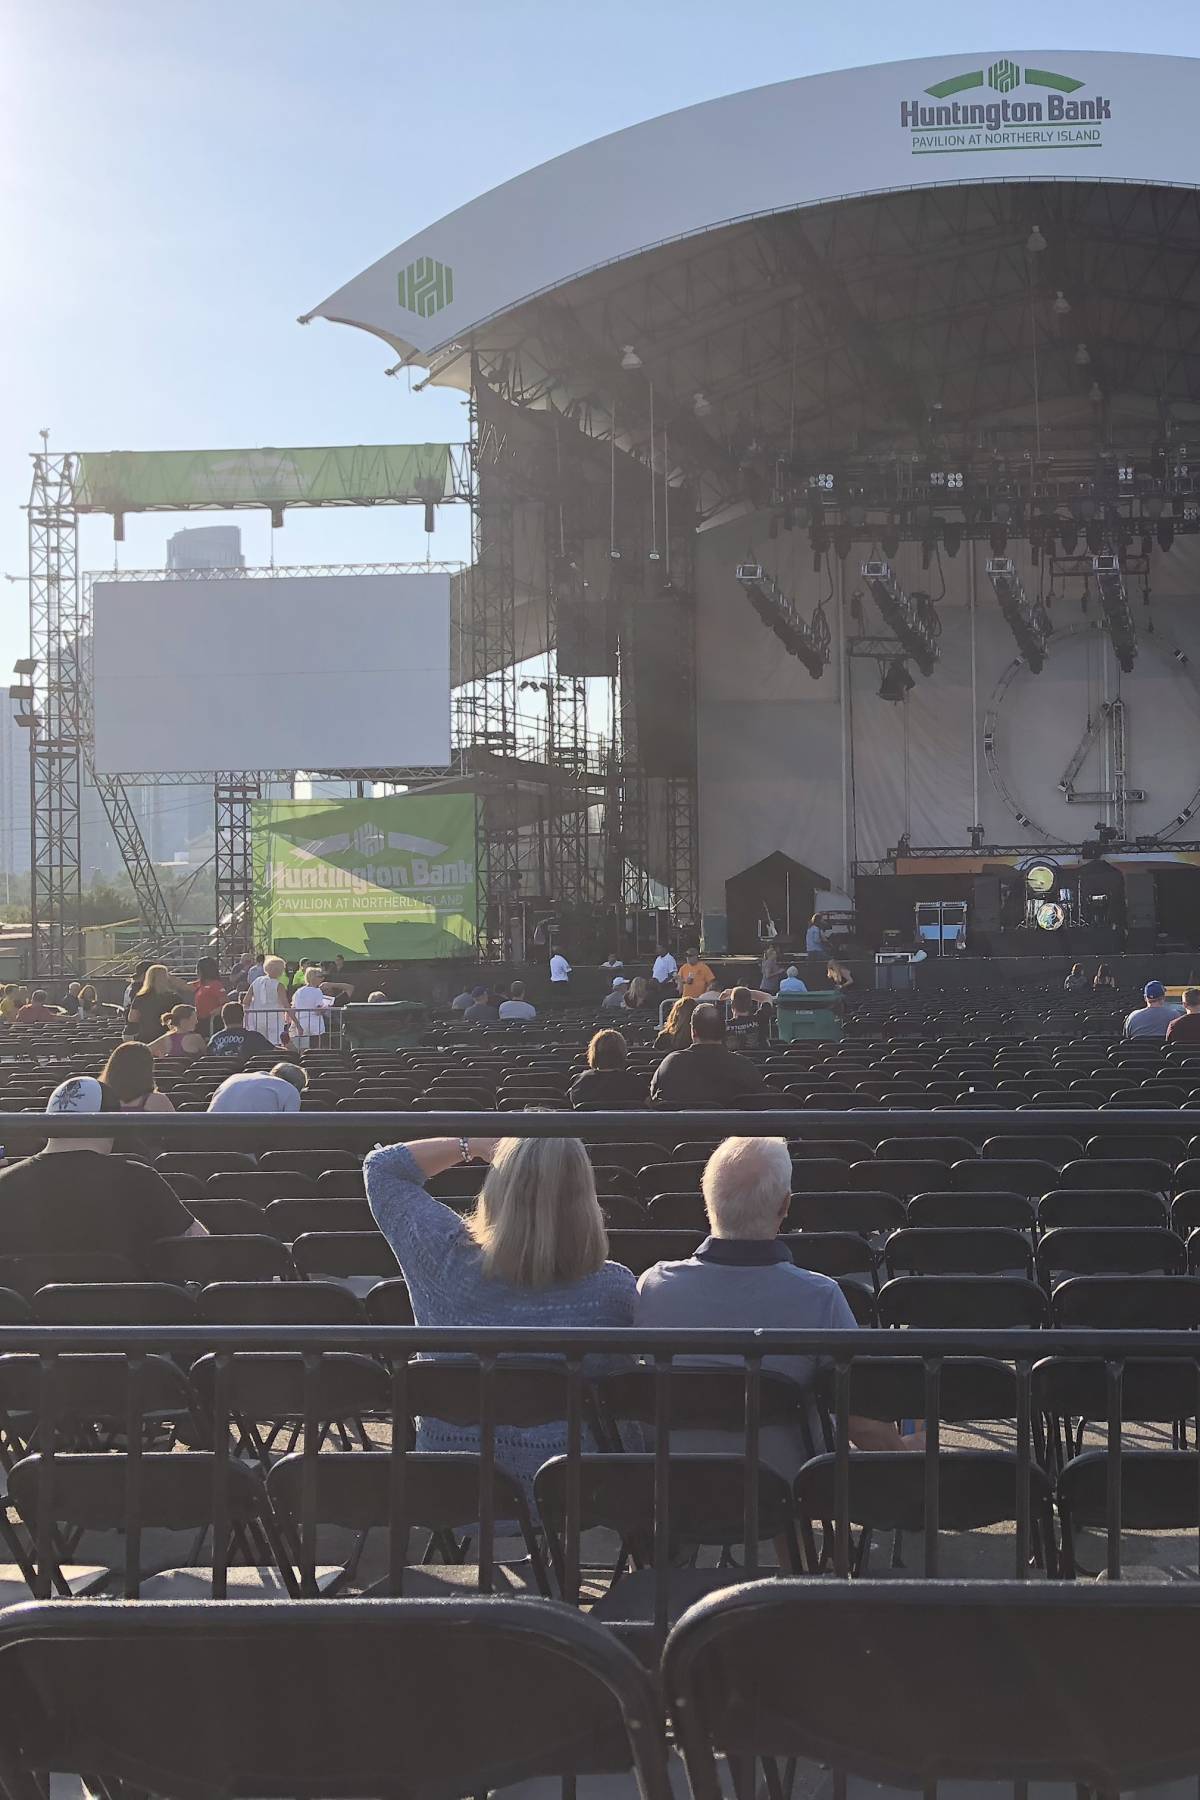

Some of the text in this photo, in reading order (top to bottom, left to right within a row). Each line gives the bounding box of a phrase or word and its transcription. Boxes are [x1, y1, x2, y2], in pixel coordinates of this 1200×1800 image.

[901, 95, 1111, 131] Huntington Bank
[912, 130, 1101, 148] PAVILION AT NORTHERLY ISLAND
[411, 859, 474, 886] Bank
[278, 894, 464, 910] PAVILION AT NORTHERLY ISLAND
